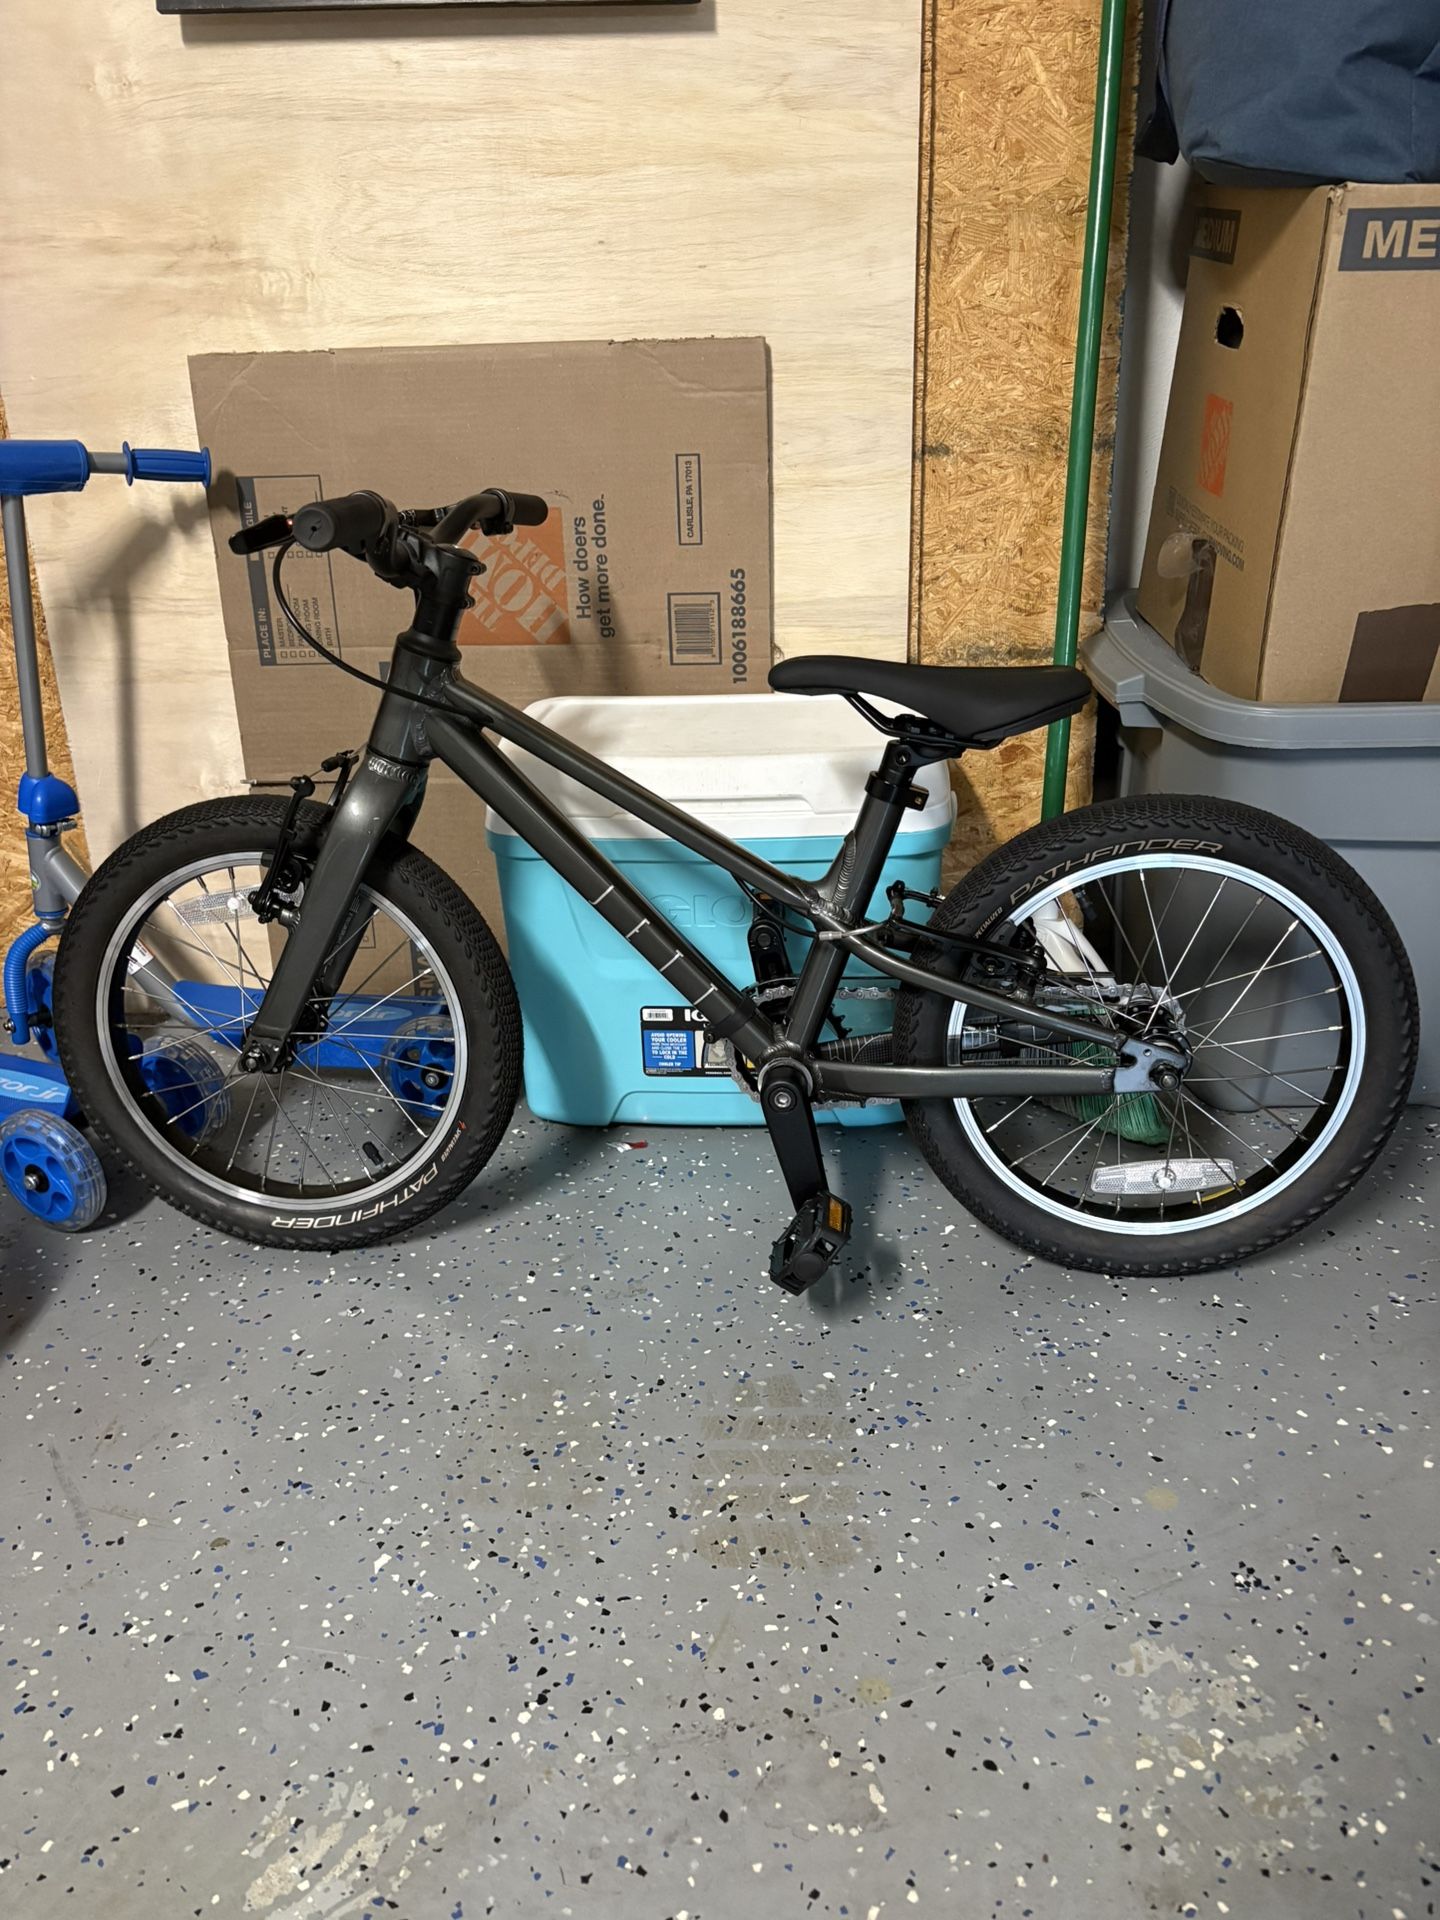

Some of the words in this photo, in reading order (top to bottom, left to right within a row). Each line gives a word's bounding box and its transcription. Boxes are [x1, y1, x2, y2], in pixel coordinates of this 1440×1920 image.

[684, 461, 692, 483] 17013
[685, 485, 693, 496] PA
[686, 497, 694, 538] CARLISLE,
[573, 516, 588, 571] doers
[576, 577, 591, 619] How
[596, 554, 610, 603] more
[259, 608, 267, 629] IN:
[276, 617, 286, 647] MASTER
[597, 608, 615, 638] get
[730, 568, 747, 684] 1006188665
[263, 631, 271, 659] PLACE
[1010, 838, 1223, 905] PATHFINDER
[271, 1161, 438, 1229] PATHFINDER
